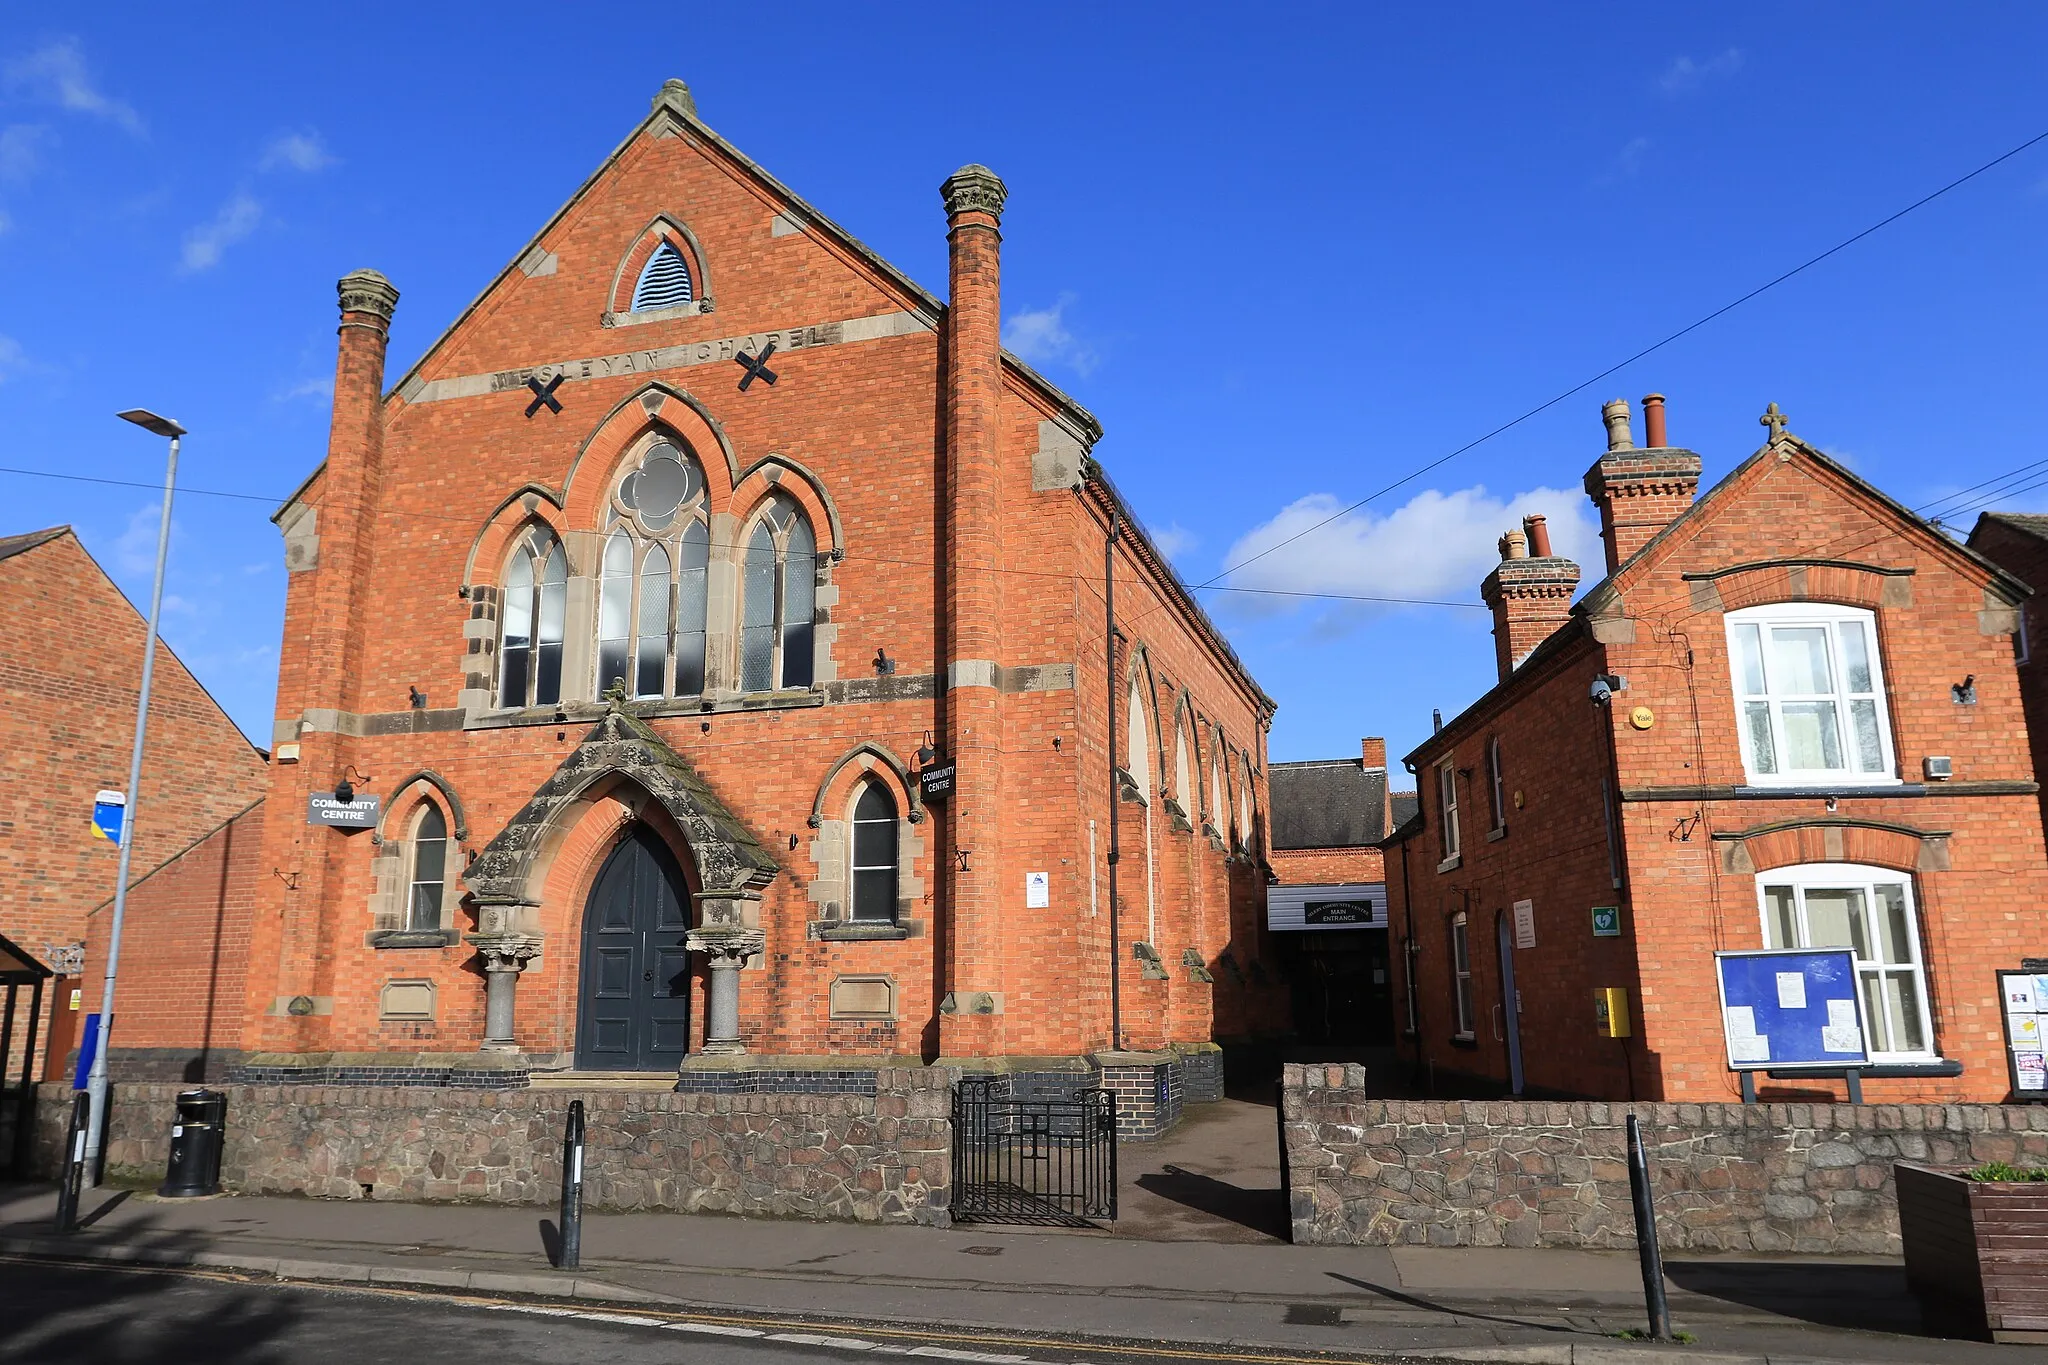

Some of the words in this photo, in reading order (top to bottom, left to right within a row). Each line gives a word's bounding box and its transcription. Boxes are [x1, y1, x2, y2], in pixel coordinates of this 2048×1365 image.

[697, 327, 827, 360] CHAPEL
[1636, 714, 1652, 722] Yale
[922, 765, 955, 783] COMMUNITY
[928, 779, 950, 793] CENTRE
[321, 810, 365, 820] CENTRE
[1351, 905, 1370, 917] CENTRE
